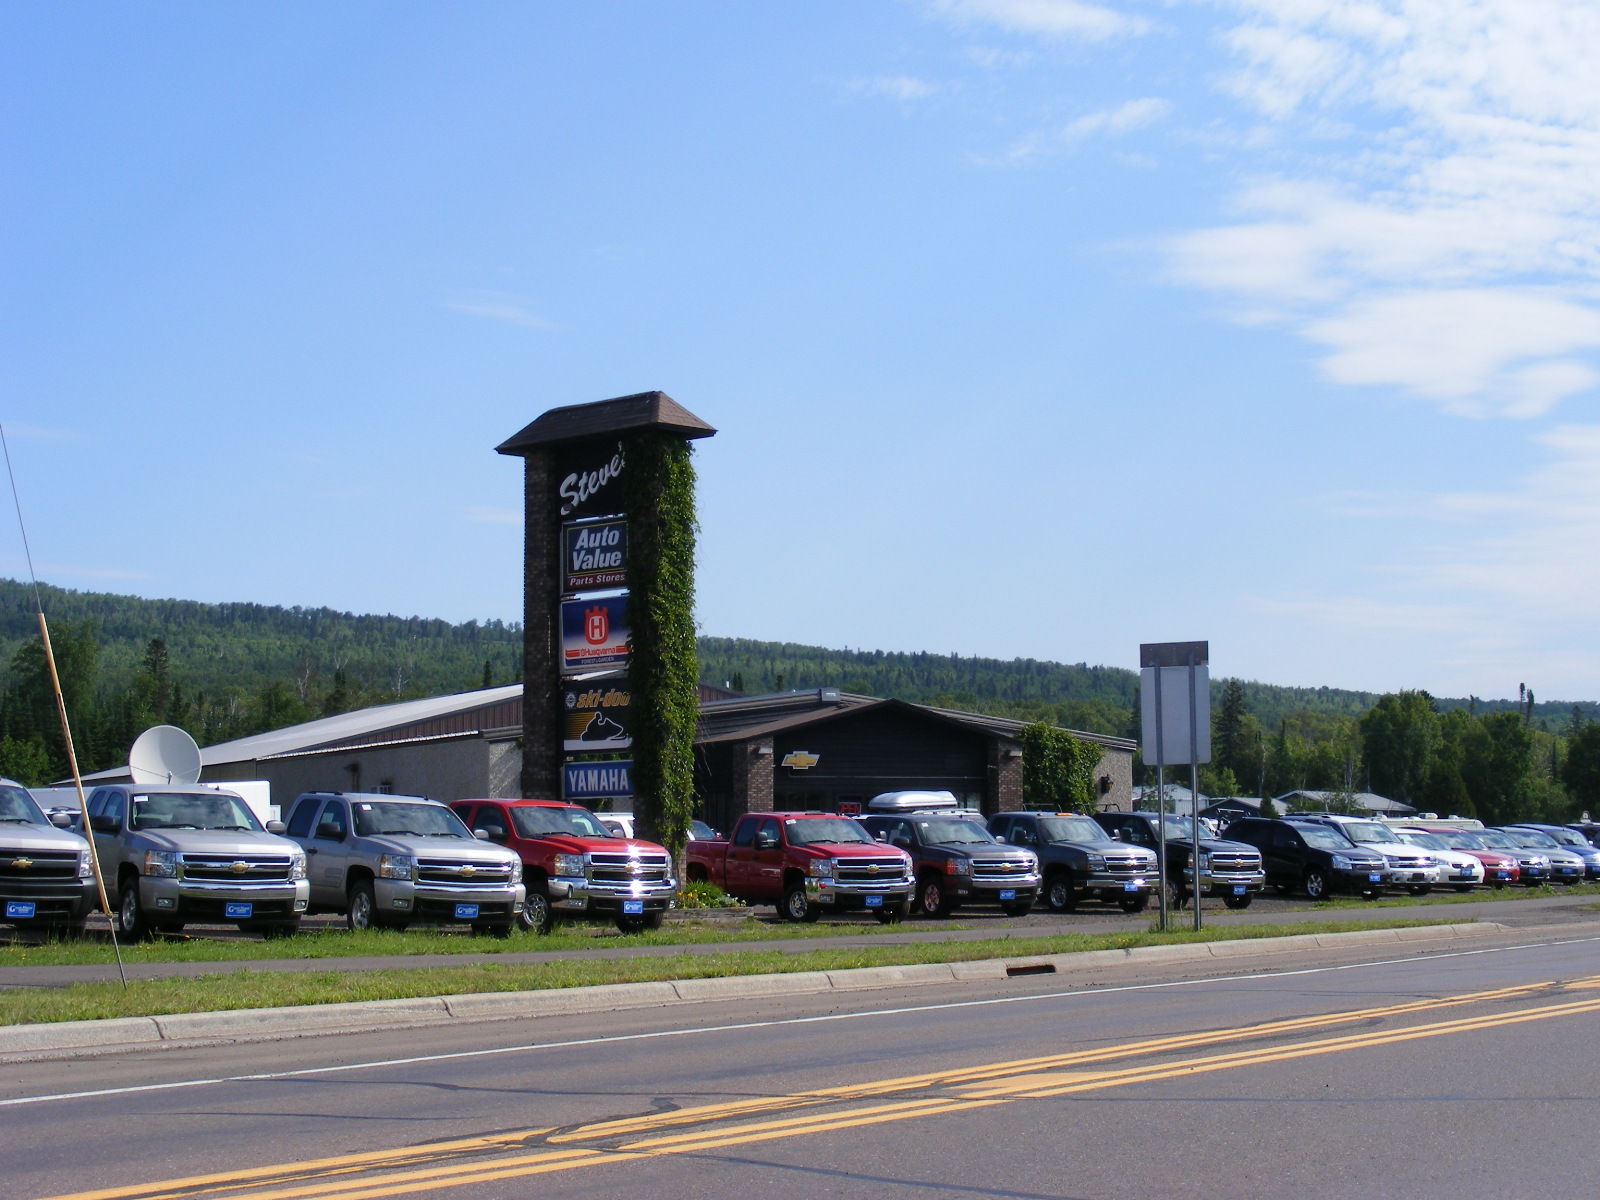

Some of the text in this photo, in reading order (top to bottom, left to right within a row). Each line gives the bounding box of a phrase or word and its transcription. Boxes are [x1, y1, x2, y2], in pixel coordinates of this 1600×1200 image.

[575, 526, 620, 550] Auto
[572, 548, 622, 571] Value
[570, 574, 625, 586] Parts Stores
[568, 768, 629, 792] YAMAHA
